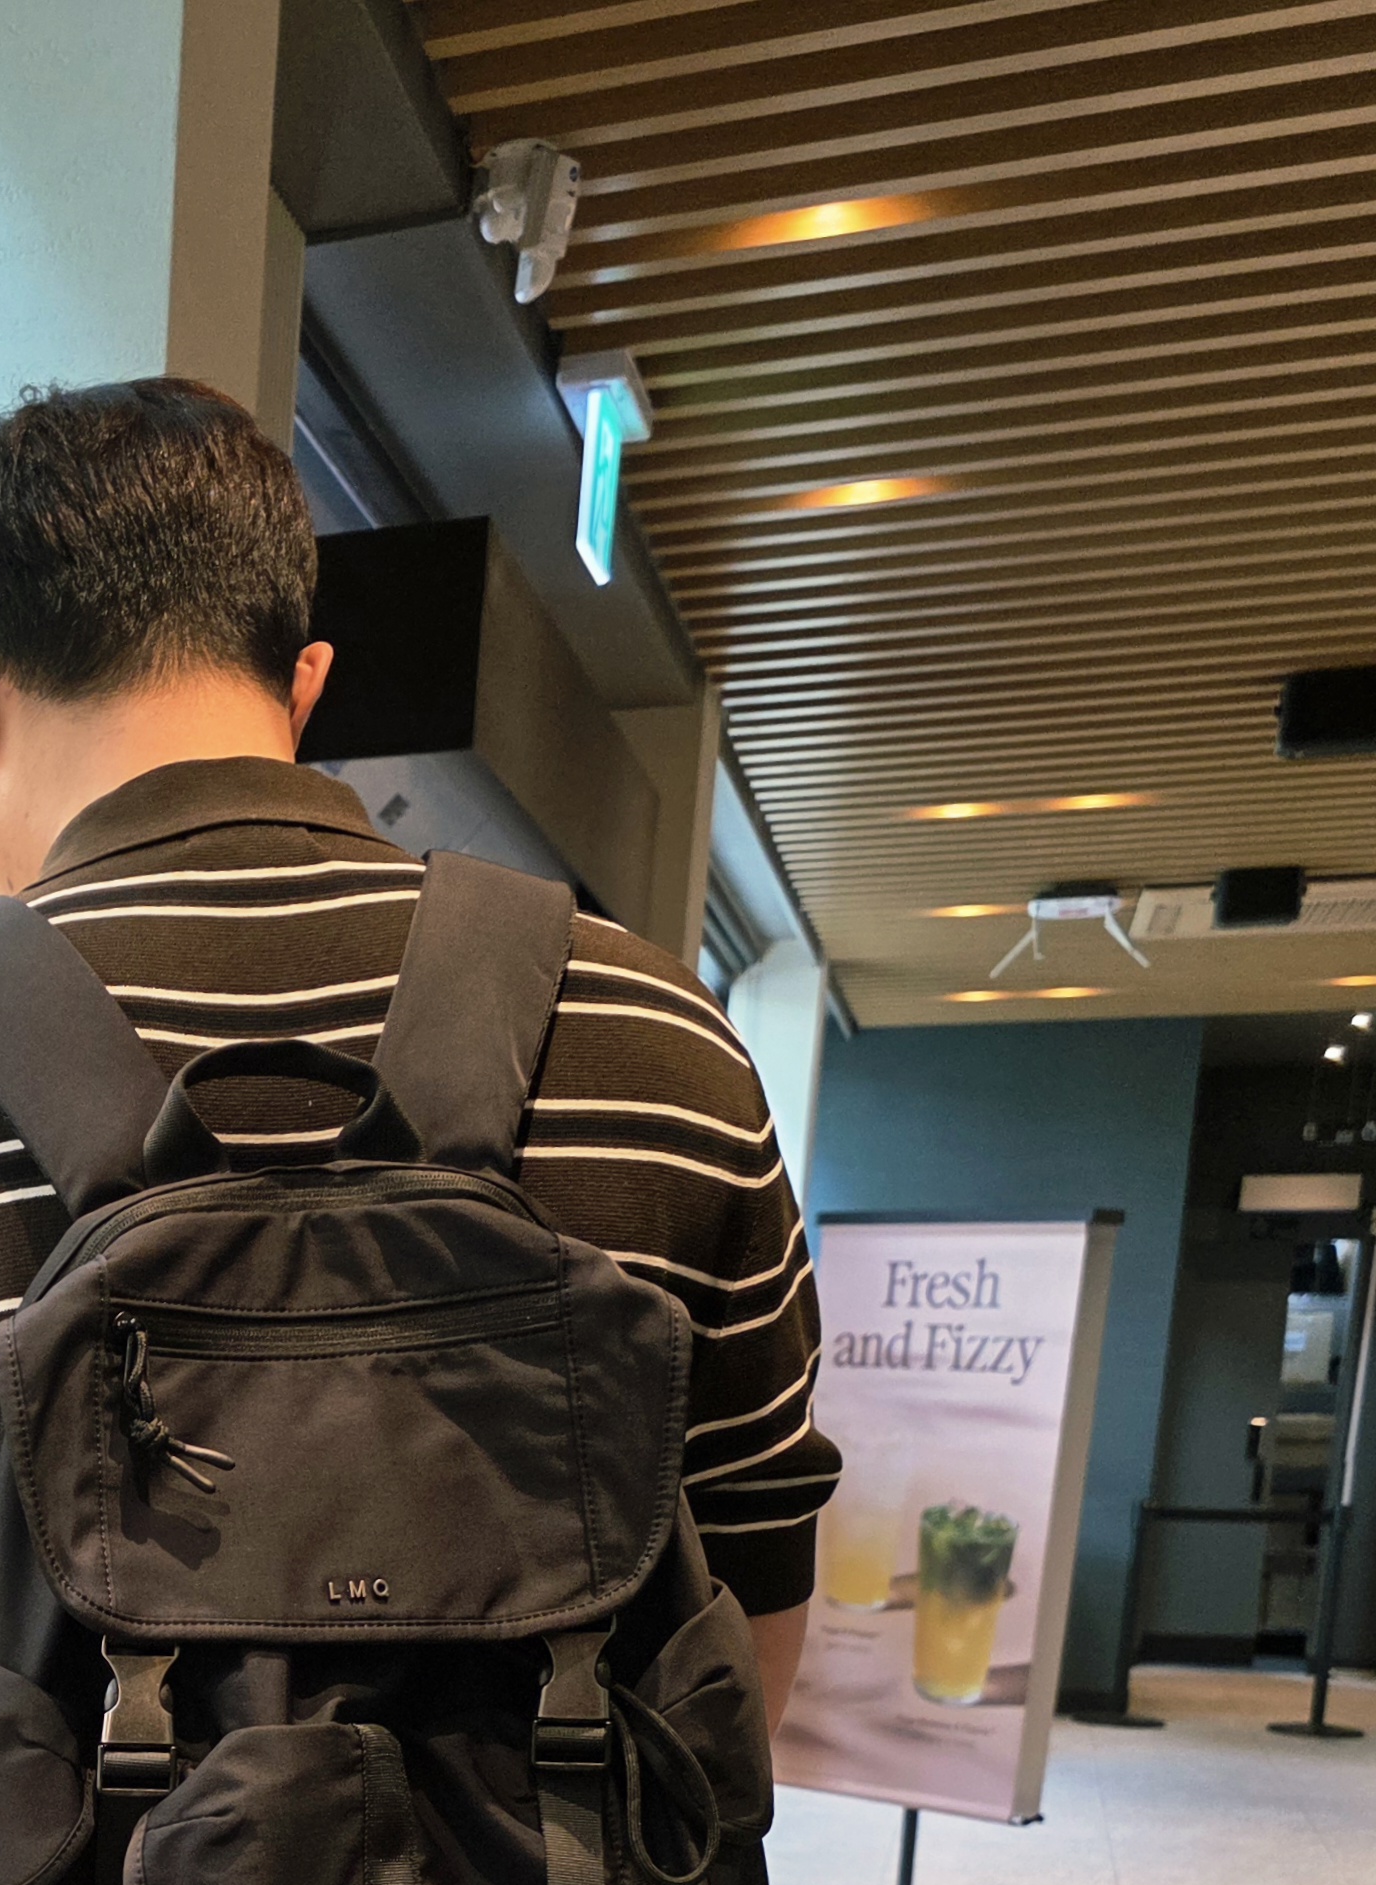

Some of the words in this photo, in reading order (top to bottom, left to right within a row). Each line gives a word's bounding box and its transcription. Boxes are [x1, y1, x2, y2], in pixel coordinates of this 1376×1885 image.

[882, 1259, 1002, 1311] Fresh
[833, 1320, 910, 1371] and
[918, 1322, 1044, 1386] Fizzy
